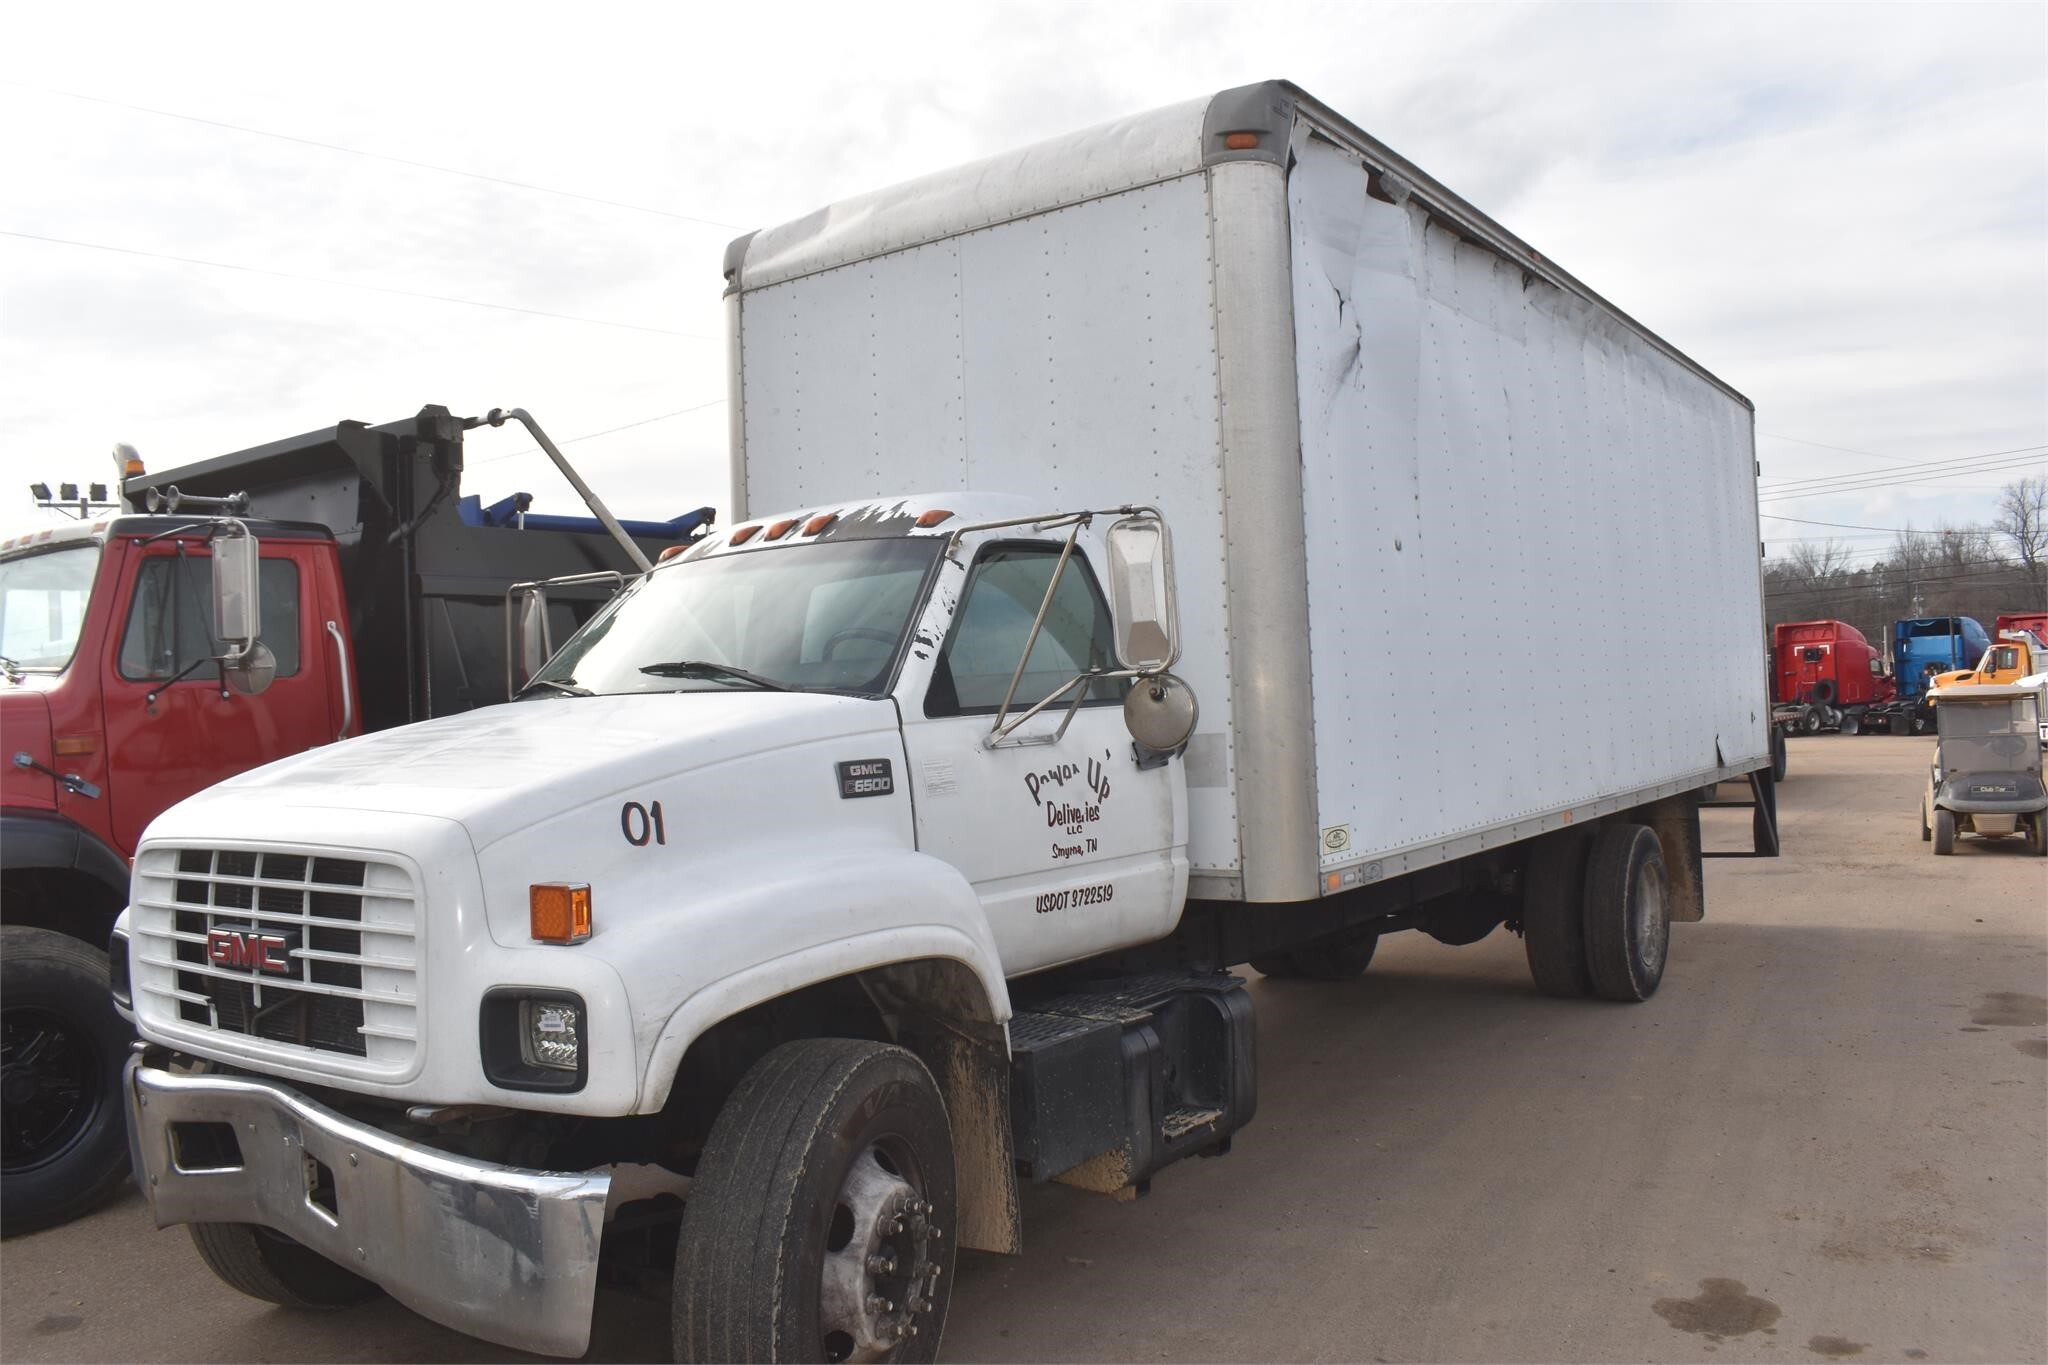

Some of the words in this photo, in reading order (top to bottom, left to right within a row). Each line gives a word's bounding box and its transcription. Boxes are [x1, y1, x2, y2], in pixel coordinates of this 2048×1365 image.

[849, 763, 883, 776] GMC
[845, 777, 891, 793] C6500
[621, 800, 666, 847] 01
[1066, 824, 1083, 835] LLC
[1051, 843, 1084, 859] Smyrna,
[1085, 837, 1098, 853] TN
[1036, 890, 1070, 914] USDOT
[1071, 884, 1113, 908] 3722519
[208, 929, 289, 973] GMC
